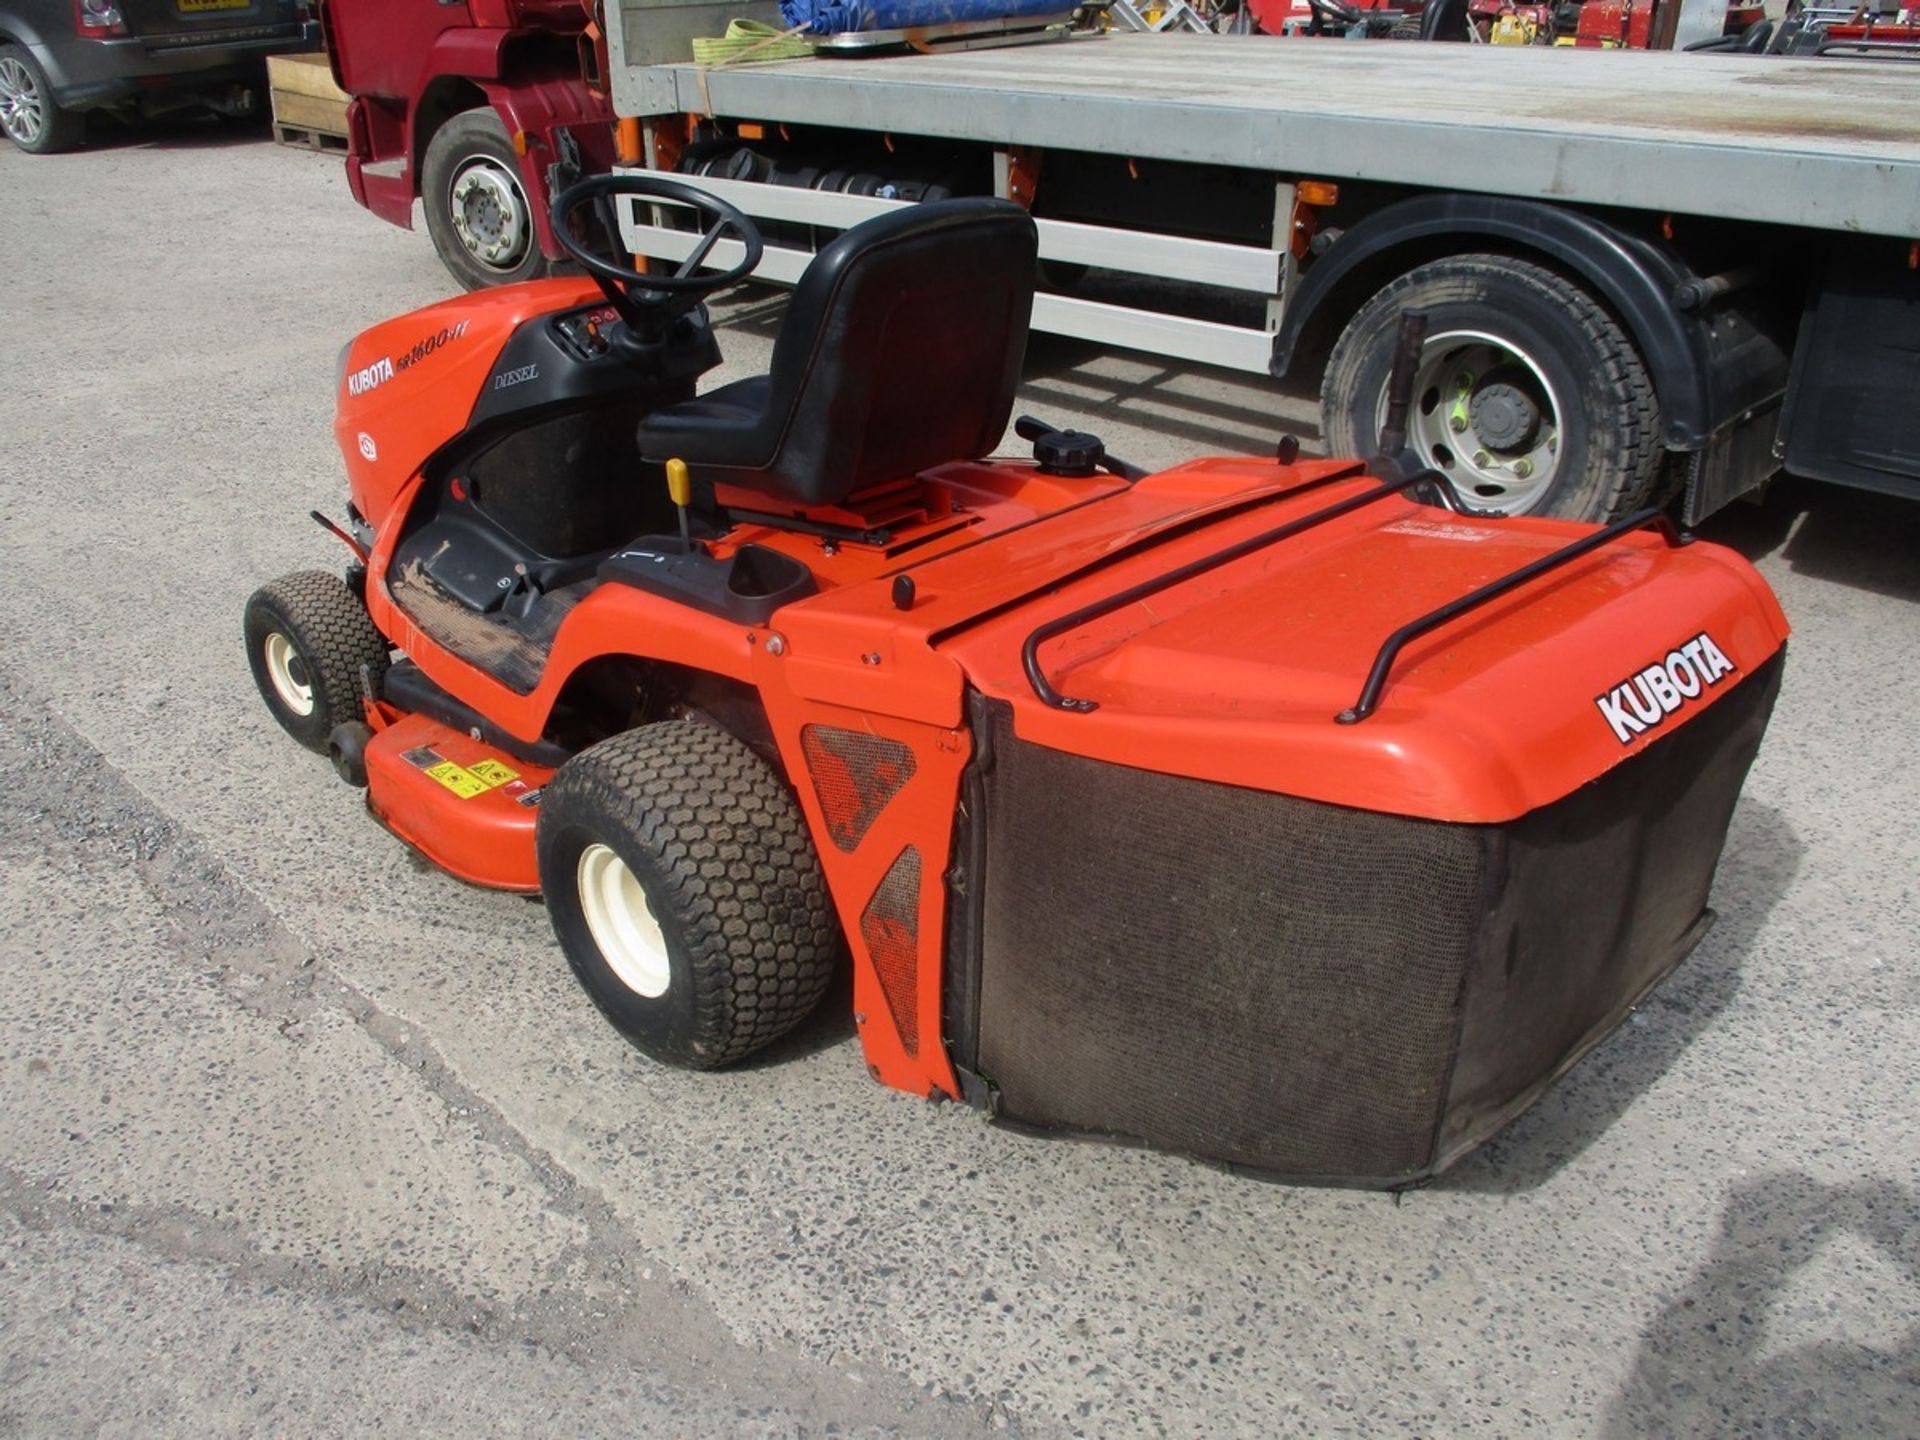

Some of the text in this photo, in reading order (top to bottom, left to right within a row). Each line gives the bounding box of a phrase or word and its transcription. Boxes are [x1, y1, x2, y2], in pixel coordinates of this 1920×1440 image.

[348, 356, 394, 397] KUBOTA
[494, 363, 539, 390] DIESEL
[1595, 632, 1736, 744] KUBOTA
